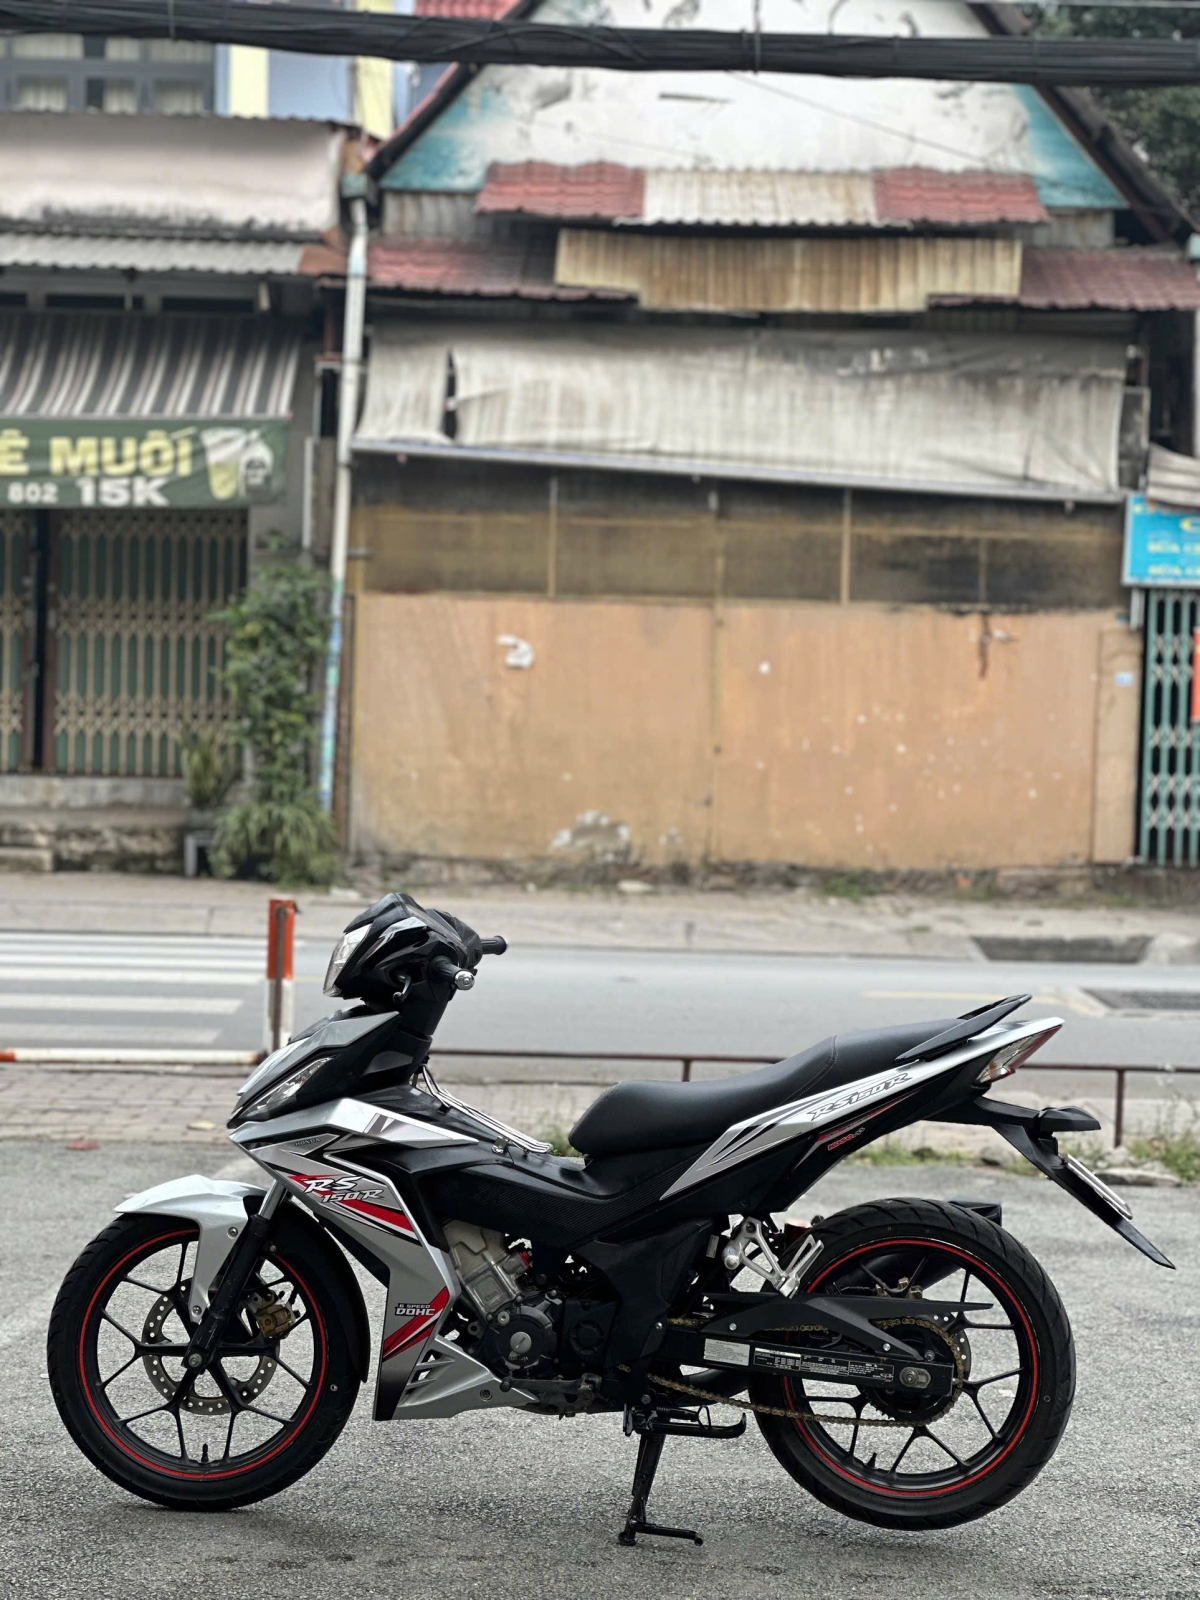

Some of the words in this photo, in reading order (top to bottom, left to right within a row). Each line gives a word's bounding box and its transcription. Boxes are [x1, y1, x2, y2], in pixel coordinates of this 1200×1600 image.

[77, 477, 169, 506] 15K
[294, 1137, 321, 1147] HONDA
[304, 1176, 363, 1194] RS
[320, 1188, 385, 1204] 150R
[395, 1308, 436, 1316] DOHC
